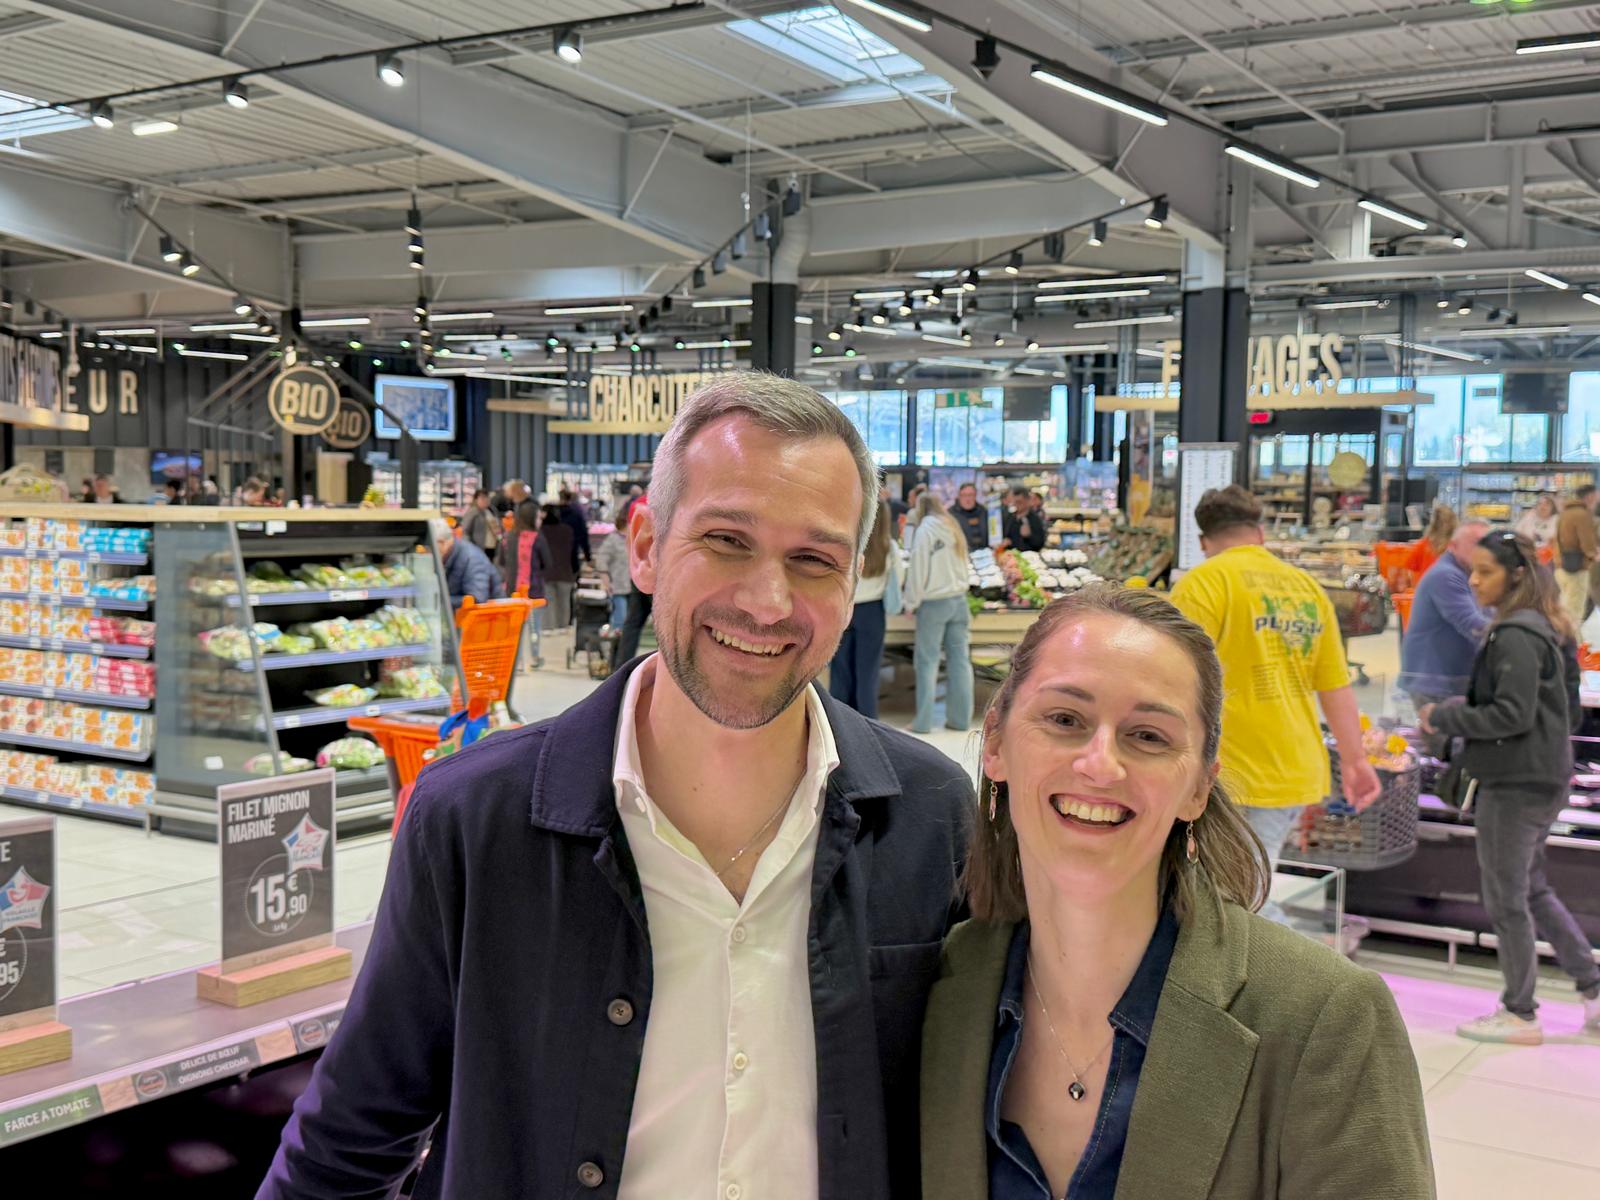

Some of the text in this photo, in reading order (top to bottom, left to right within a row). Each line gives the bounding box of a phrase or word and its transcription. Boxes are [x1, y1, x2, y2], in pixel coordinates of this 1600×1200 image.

[1162, 333, 1343, 398] FAGES
[280, 379, 328, 420] BIO
[590, 372, 724, 424] CHARCUT
[227, 789, 310, 822] FILET MIGNON
[227, 815, 276, 844] MARINÉ
[250, 873, 286, 924] 15
[4, 1098, 91, 1133] FARCE A TOMATE
